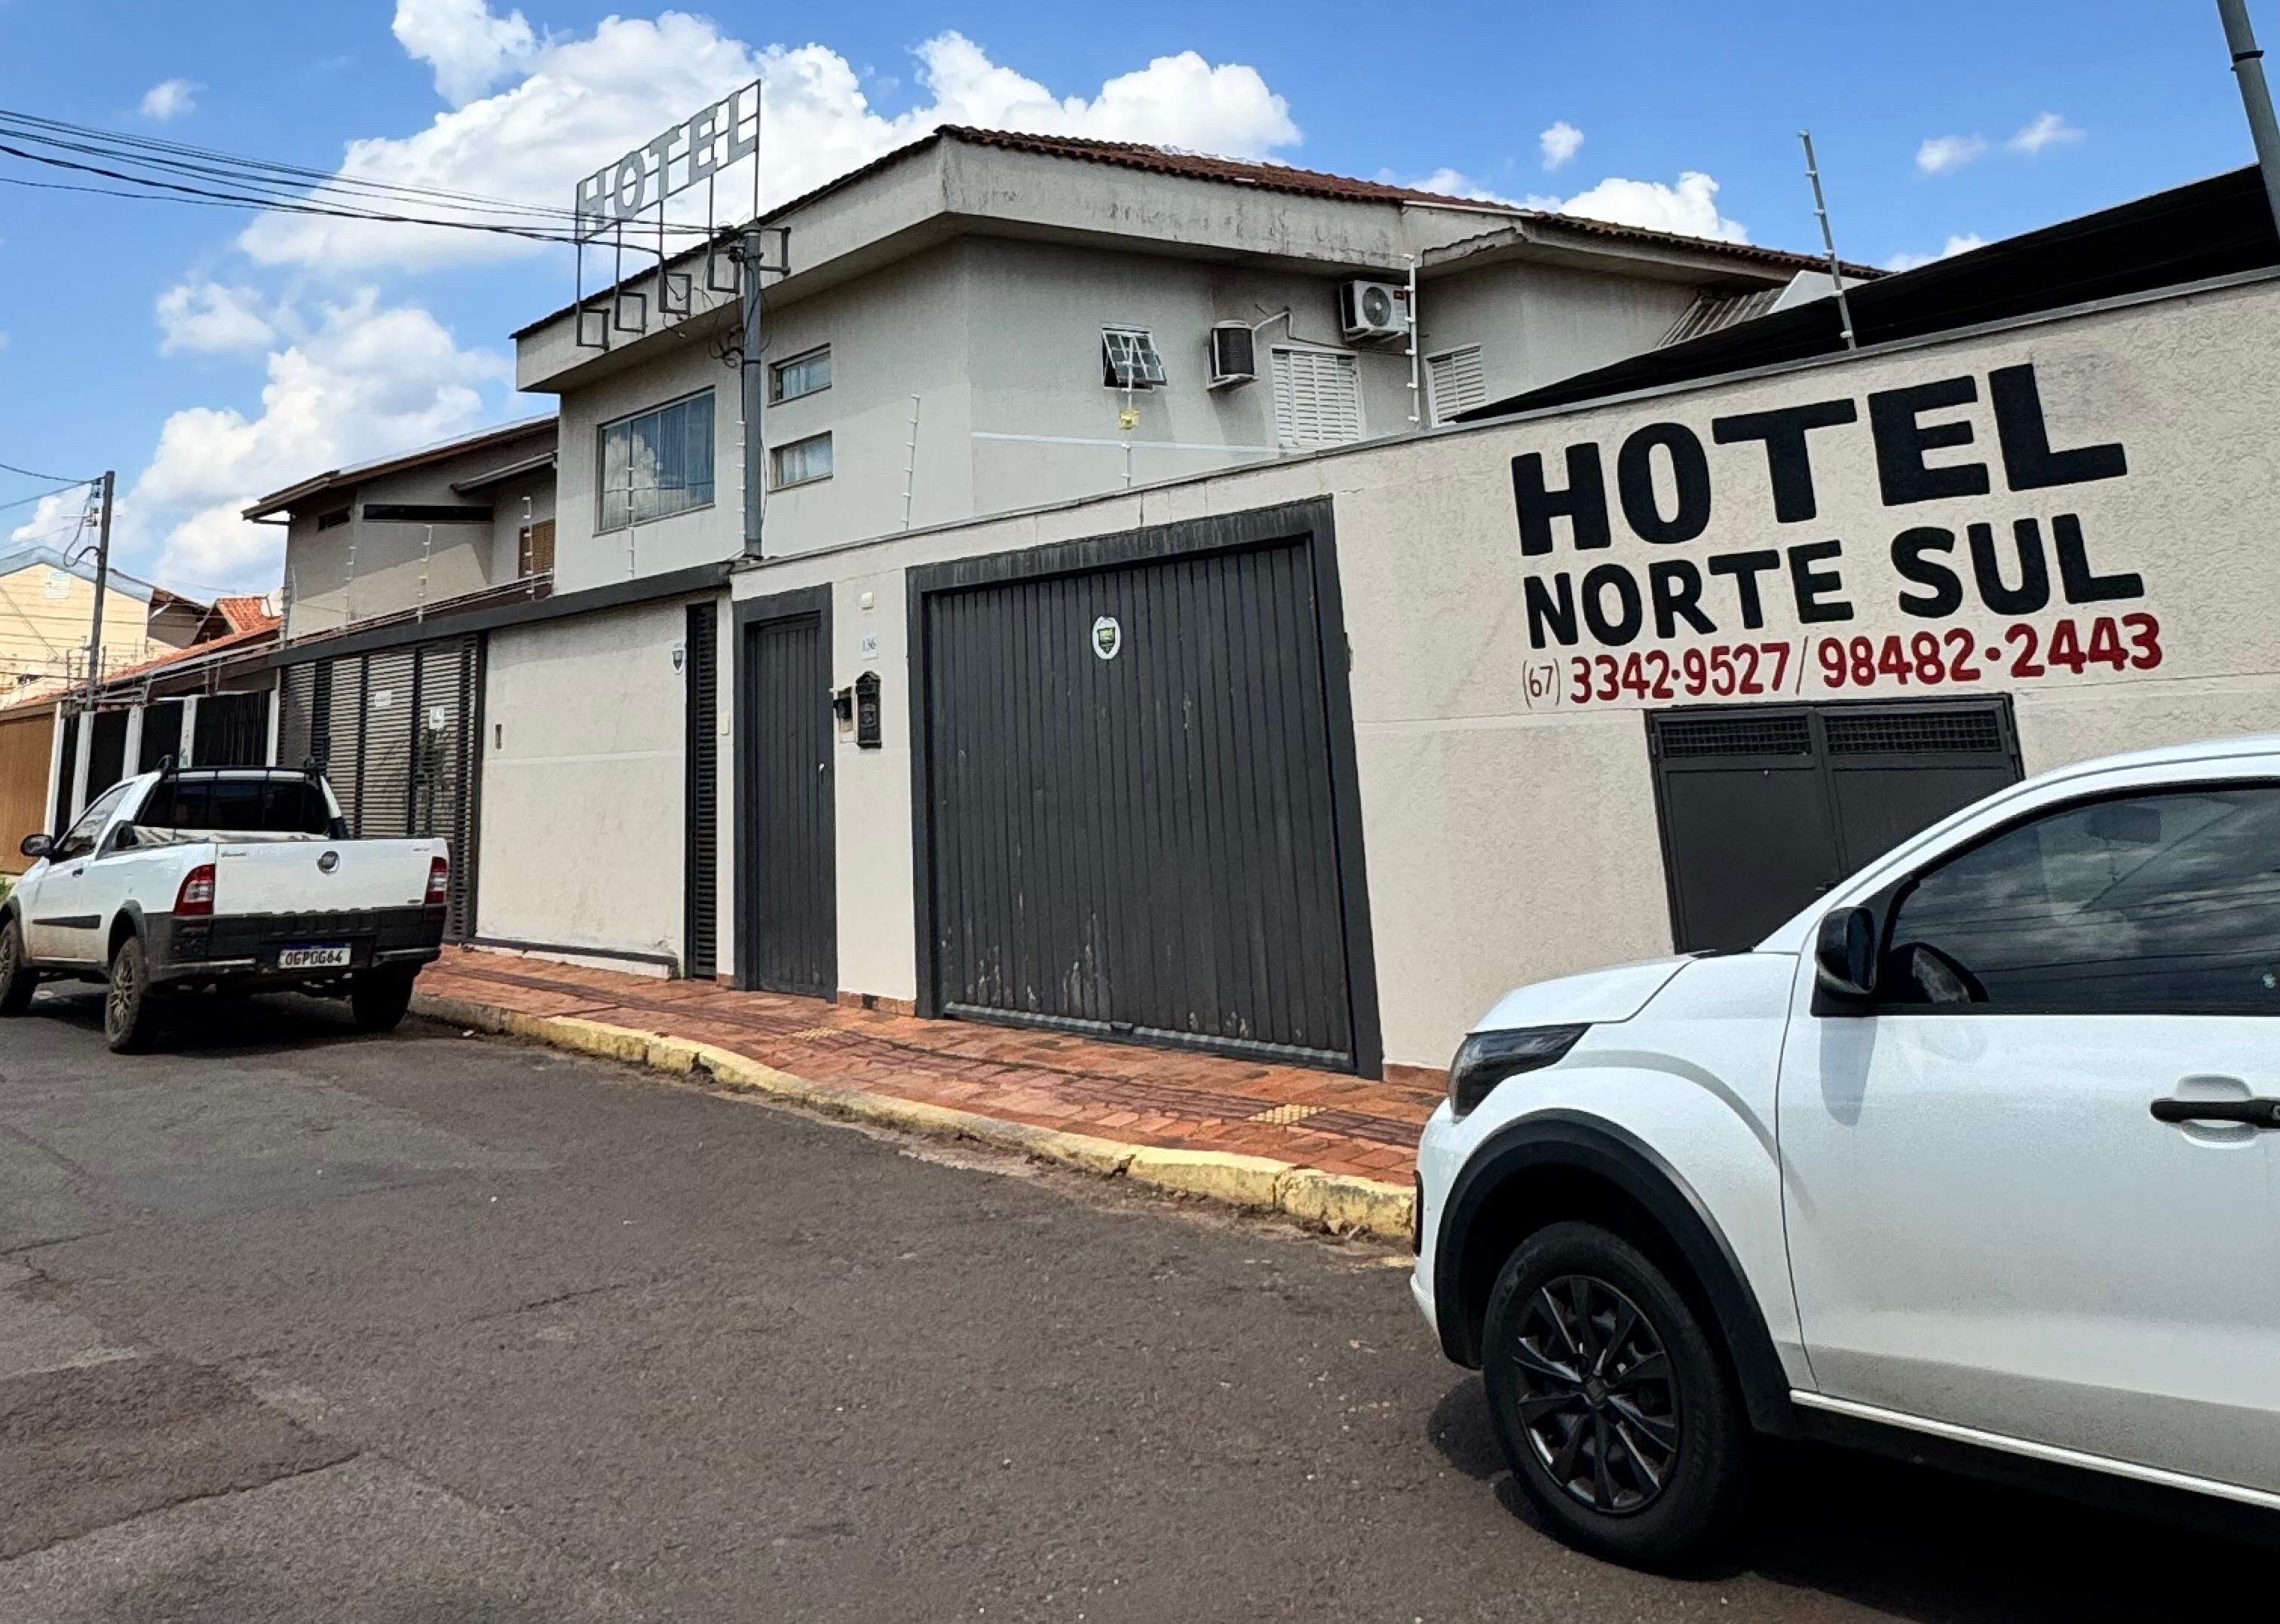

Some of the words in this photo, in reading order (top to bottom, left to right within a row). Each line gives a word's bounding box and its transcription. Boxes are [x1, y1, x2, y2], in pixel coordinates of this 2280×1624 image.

[578, 90, 757, 239] HOTEL
[1511, 363, 2128, 556] HOTEL
[1523, 539, 1855, 649] NORTE
[1891, 513, 2145, 618] SUL
[1522, 657, 1561, 709] (67)
